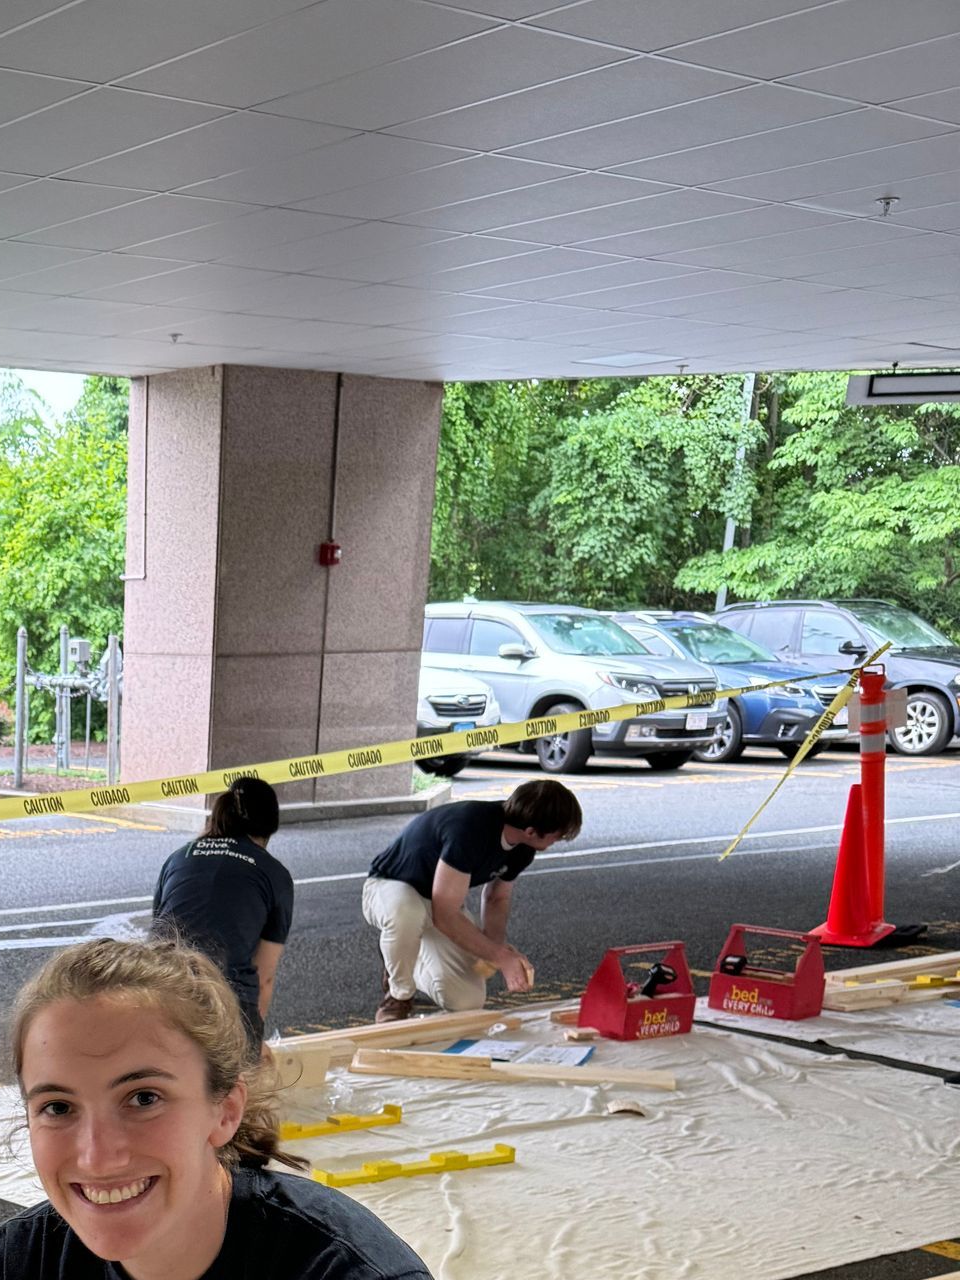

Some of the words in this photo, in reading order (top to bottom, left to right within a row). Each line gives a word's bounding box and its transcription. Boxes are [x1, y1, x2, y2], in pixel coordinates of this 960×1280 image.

[23, 795, 65, 815] CAUTION
[90, 787, 131, 807] CUIDADO
[161, 778, 200, 797] CAUTION
[289, 758, 325, 777] CAUTION
[347, 749, 383, 768] CUIDADO
[410, 738, 444, 757] CAUTION
[466, 729, 499, 748] CUIDADO
[525, 718, 558, 737] CAUTION
[578, 709, 611, 728] CUIDADO
[636, 699, 666, 717] CAUTION
[732, 985, 759, 1004] bed
[643, 1007, 668, 1026] bed
